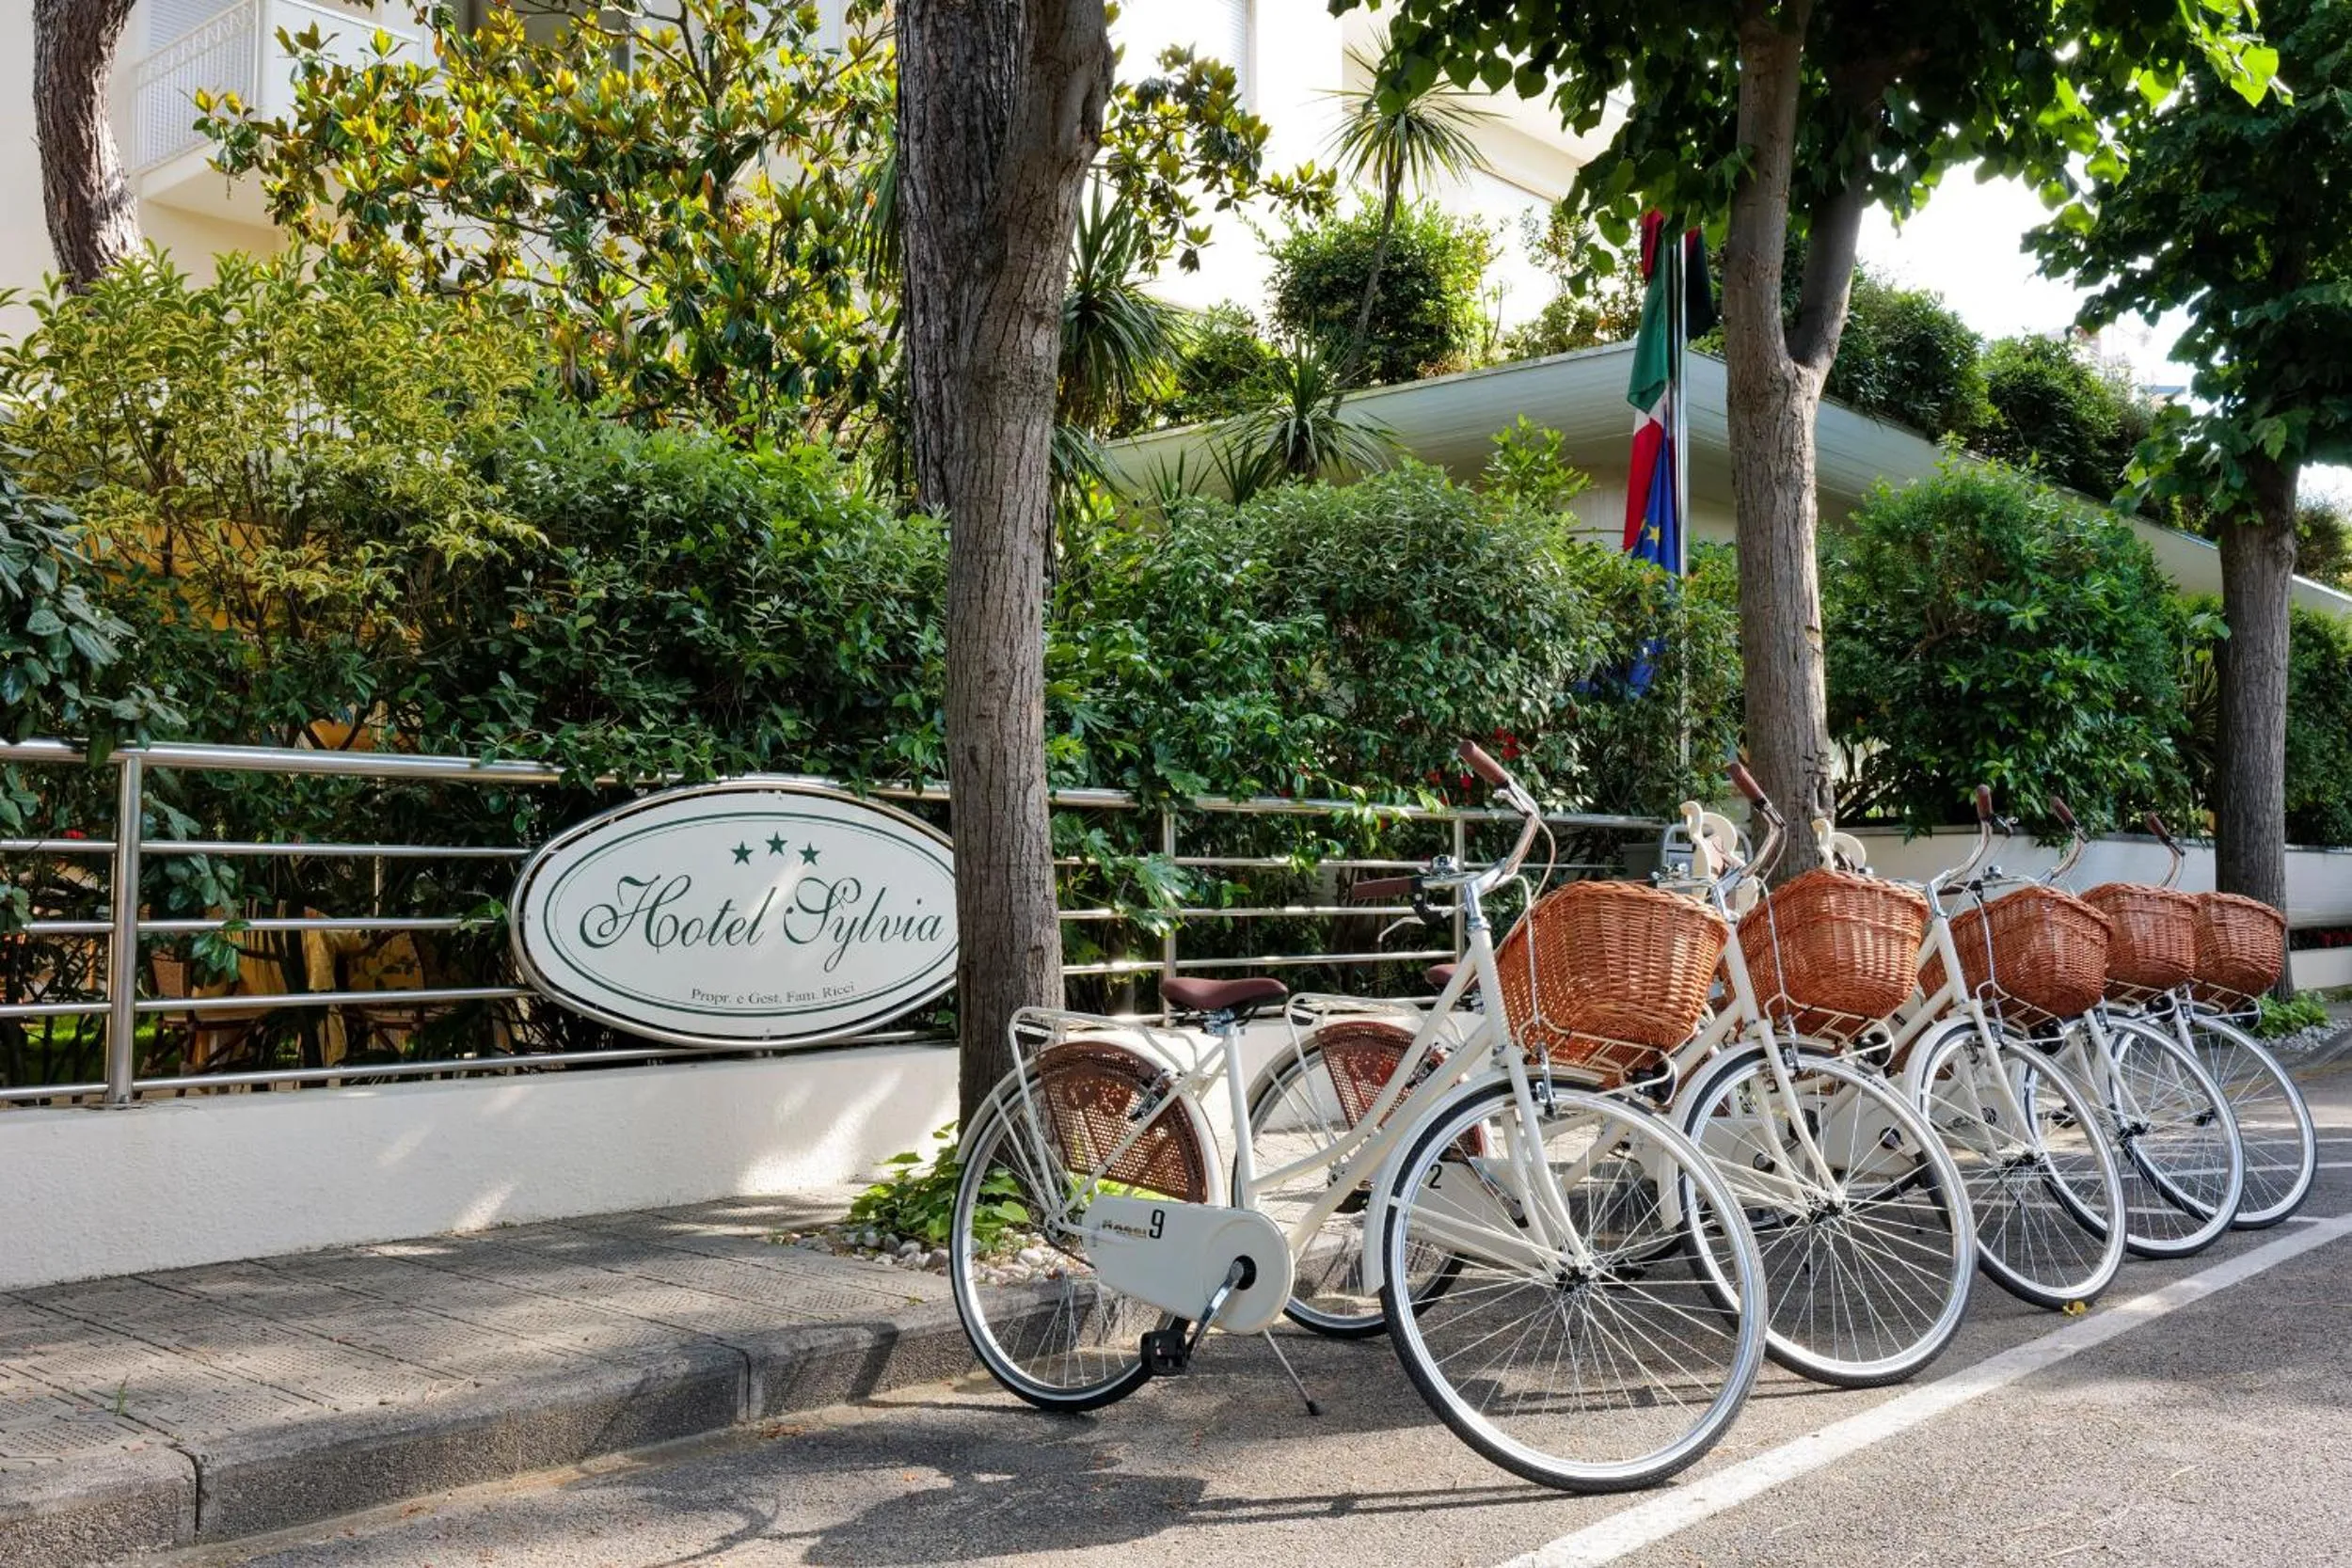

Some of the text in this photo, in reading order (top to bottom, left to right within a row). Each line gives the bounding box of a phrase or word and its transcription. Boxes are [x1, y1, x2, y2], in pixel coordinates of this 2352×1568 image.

[579, 874, 946, 973] Hotel Sylvia
[691, 988, 731, 1006] Propr.
[736, 993, 744, 1004] e
[821, 980, 855, 999] Ricci
[1428, 1164, 1443, 1190] 2
[1149, 1209, 1166, 1240] 9
